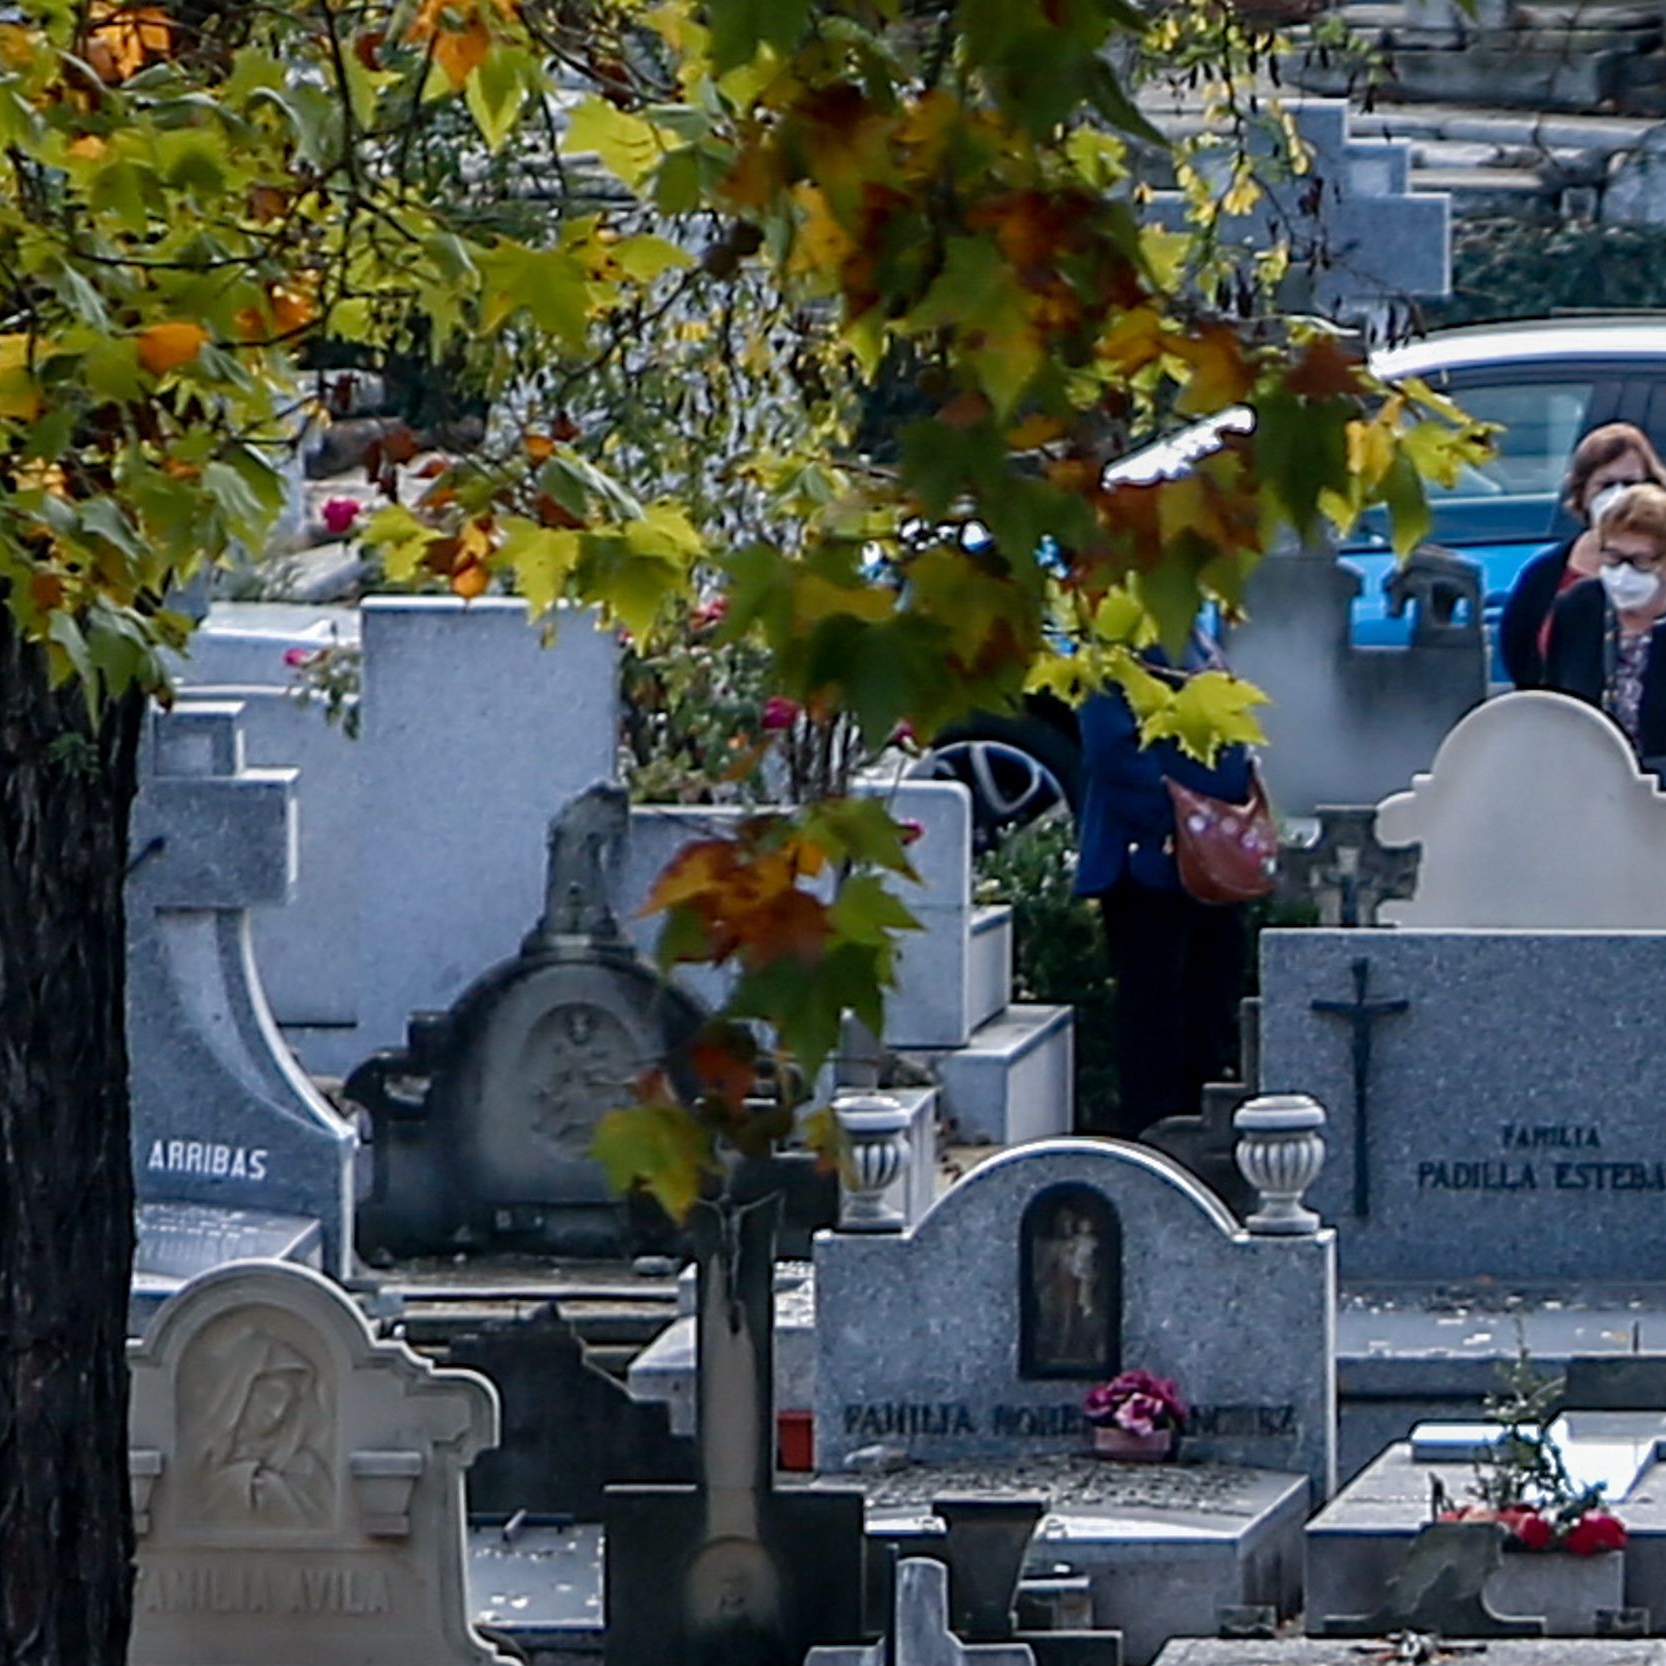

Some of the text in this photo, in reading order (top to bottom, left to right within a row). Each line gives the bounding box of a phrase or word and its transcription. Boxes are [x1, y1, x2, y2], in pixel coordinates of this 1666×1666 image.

[1501, 1124, 1602, 1148] FAMILIA
[147, 1139, 269, 1180] ARRIBAS
[1418, 1161, 1537, 1190] PADILLA
[843, 1402, 974, 1435] FAMILIA
[136, 1568, 271, 1612] AMILIA
